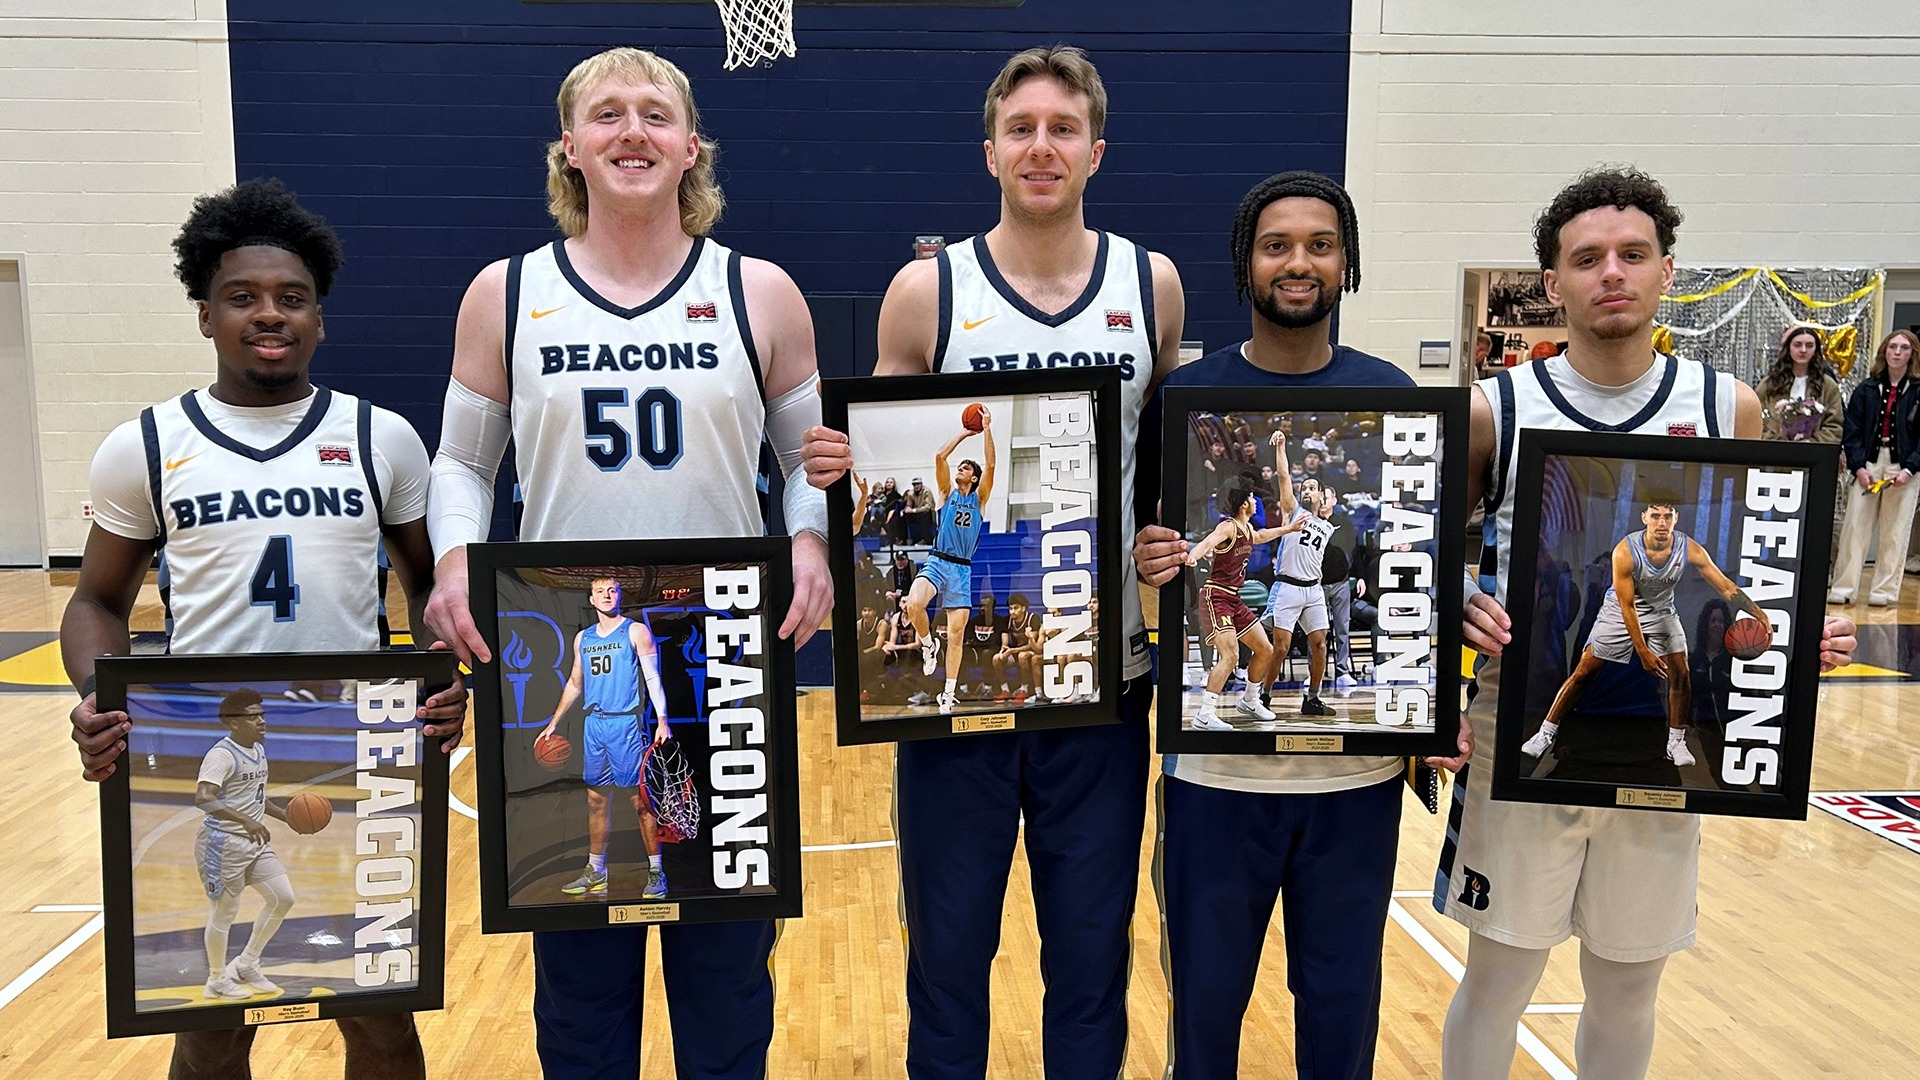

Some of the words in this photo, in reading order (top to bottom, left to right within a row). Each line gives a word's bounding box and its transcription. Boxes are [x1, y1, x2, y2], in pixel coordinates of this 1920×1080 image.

[540, 342, 719, 376] BEACONS
[581, 386, 684, 472] 50
[171, 487, 365, 530] BEACONS
[954, 510, 972, 527] 22
[1038, 392, 1096, 699] BEACONS
[1298, 529, 1323, 552] 24
[249, 534, 300, 622] 4
[1375, 414, 1437, 725] BEACONS
[1221, 615, 1232, 625] N
[582, 641, 622, 654] BUSHNELL
[590, 654, 611, 676] 50
[703, 566, 770, 889] BEACONS
[242, 769, 268, 781] BEACO
[354, 680, 417, 987] BEACONS
[1457, 864, 1491, 911] B
